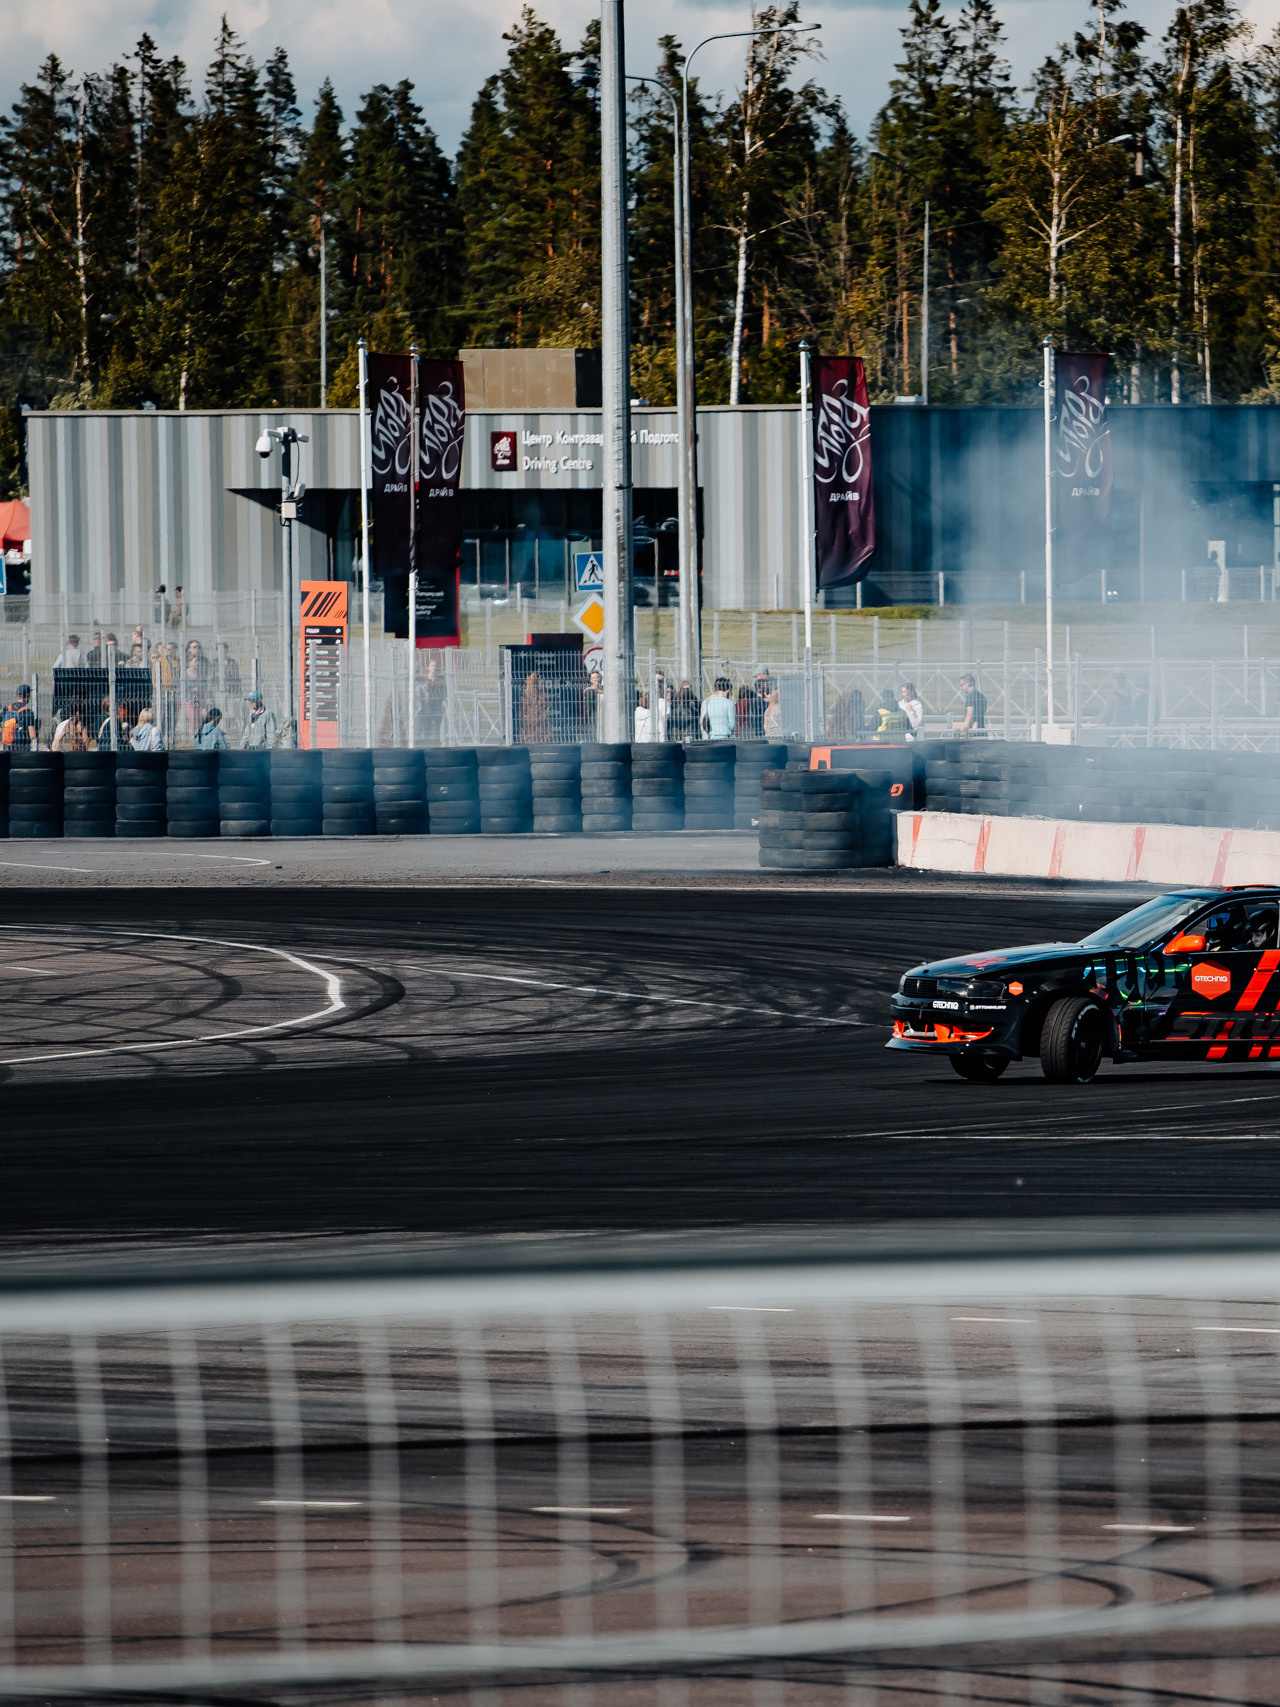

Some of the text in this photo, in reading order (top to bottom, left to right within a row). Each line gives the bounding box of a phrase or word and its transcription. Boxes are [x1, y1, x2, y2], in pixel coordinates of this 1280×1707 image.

[522, 430, 553, 447] Центр
[522, 456, 557, 473] Driving
[560, 456, 594, 471] Centre
[384, 483, 408, 493] ДРАЙВ
[429, 488, 454, 497] ДРАЙВ
[1071, 487, 1100, 497] ДРАЙВ
[829, 491, 860, 502] ДРАЙВ
[932, 1000, 959, 1010] GTECHNIQ
